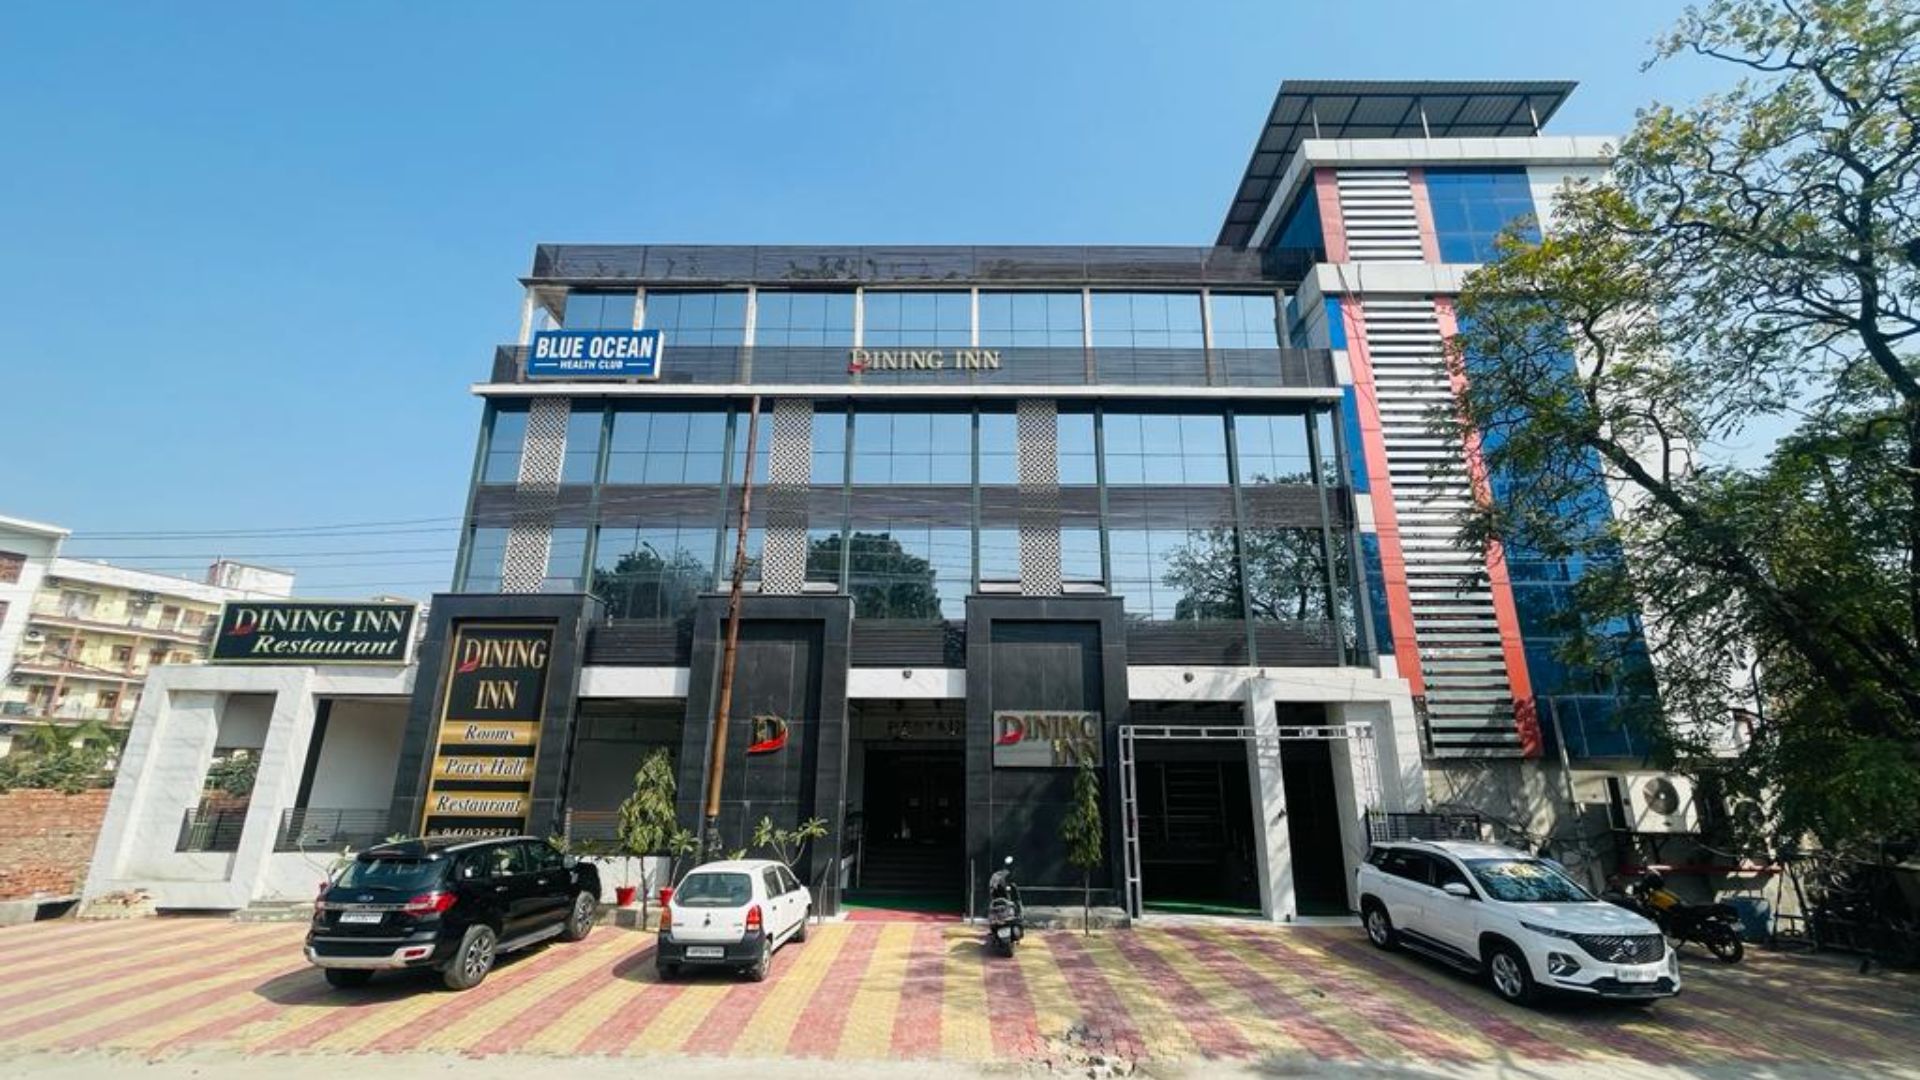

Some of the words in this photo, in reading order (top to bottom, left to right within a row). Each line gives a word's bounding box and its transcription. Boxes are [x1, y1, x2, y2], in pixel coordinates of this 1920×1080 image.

[536, 337, 585, 358] BLUE
[589, 337, 654, 358] OCEAN
[560, 360, 596, 370] HEALTH
[598, 360, 624, 370] CLUB
[848, 349, 944, 373] DINING
[955, 350, 1001, 369] INN
[228, 608, 345, 636] DINING
[350, 610, 407, 633] INN
[251, 635, 399, 655] Restaurant
[458, 638, 547, 672] DINING
[474, 680, 519, 709] INN
[464, 724, 516, 741] Rooms
[995, 715, 1098, 745] DINING
[445, 758, 486, 775] Party
[490, 757, 528, 775] Hall
[436, 794, 522, 813] Restaurant
